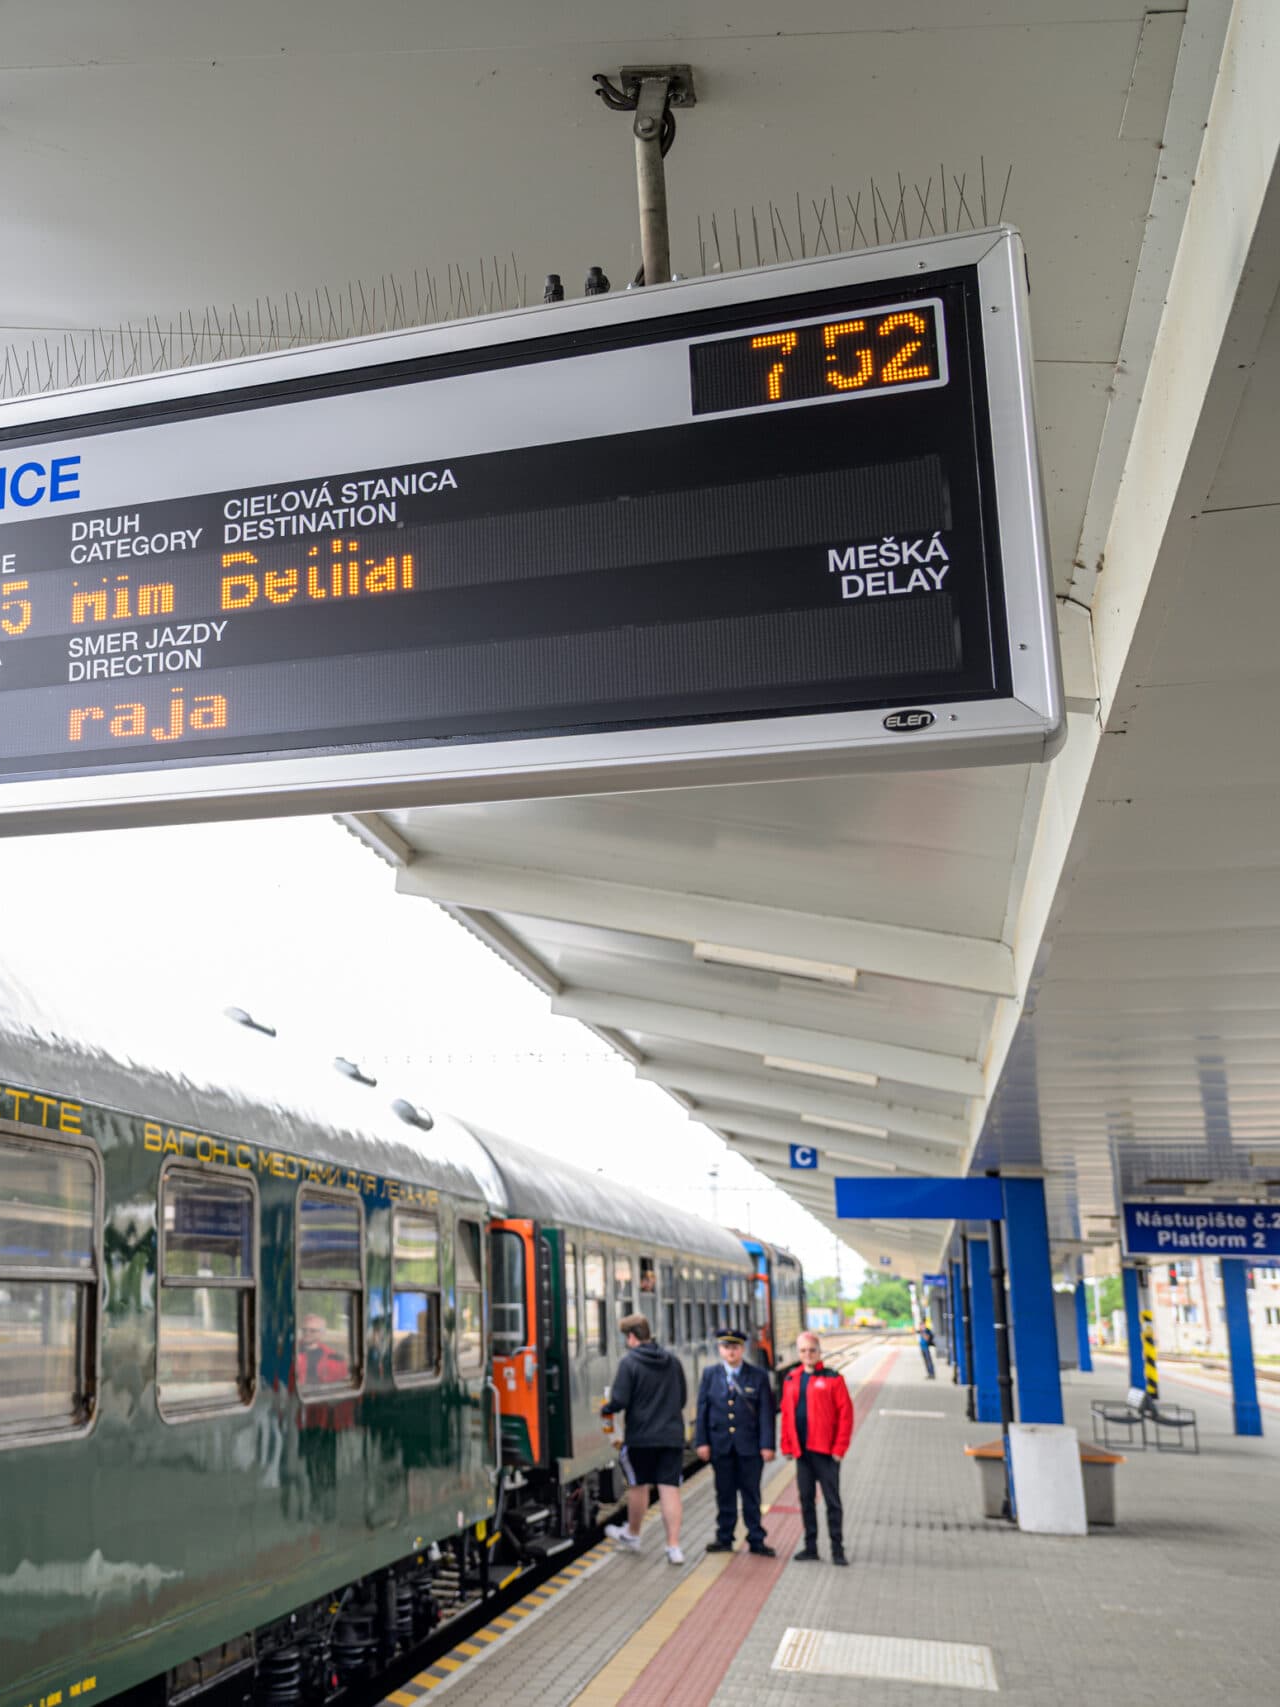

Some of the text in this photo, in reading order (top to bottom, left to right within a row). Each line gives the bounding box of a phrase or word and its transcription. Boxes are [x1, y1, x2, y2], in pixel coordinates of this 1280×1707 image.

[752, 312, 929, 399] 7 52
[223, 469, 458, 520] CIEĽOVÁ STANICA
[70, 513, 141, 542] DRUH
[224, 502, 397, 544] DESTINATION
[70, 527, 203, 565] CATEGORY
[827, 531, 949, 573] MEŠKÁ
[841, 565, 950, 599] DELAY
[68, 621, 228, 659] SMER JAZDY
[68, 648, 203, 682] DIRECTION
[144, 1122, 228, 1165] ВАГОН
[235, 1145, 253, 1169] С
[795, 1147, 812, 1166] C
[1135, 1210, 1247, 1230] Nástupište
[1157, 1230, 1266, 1248] Platform 2
